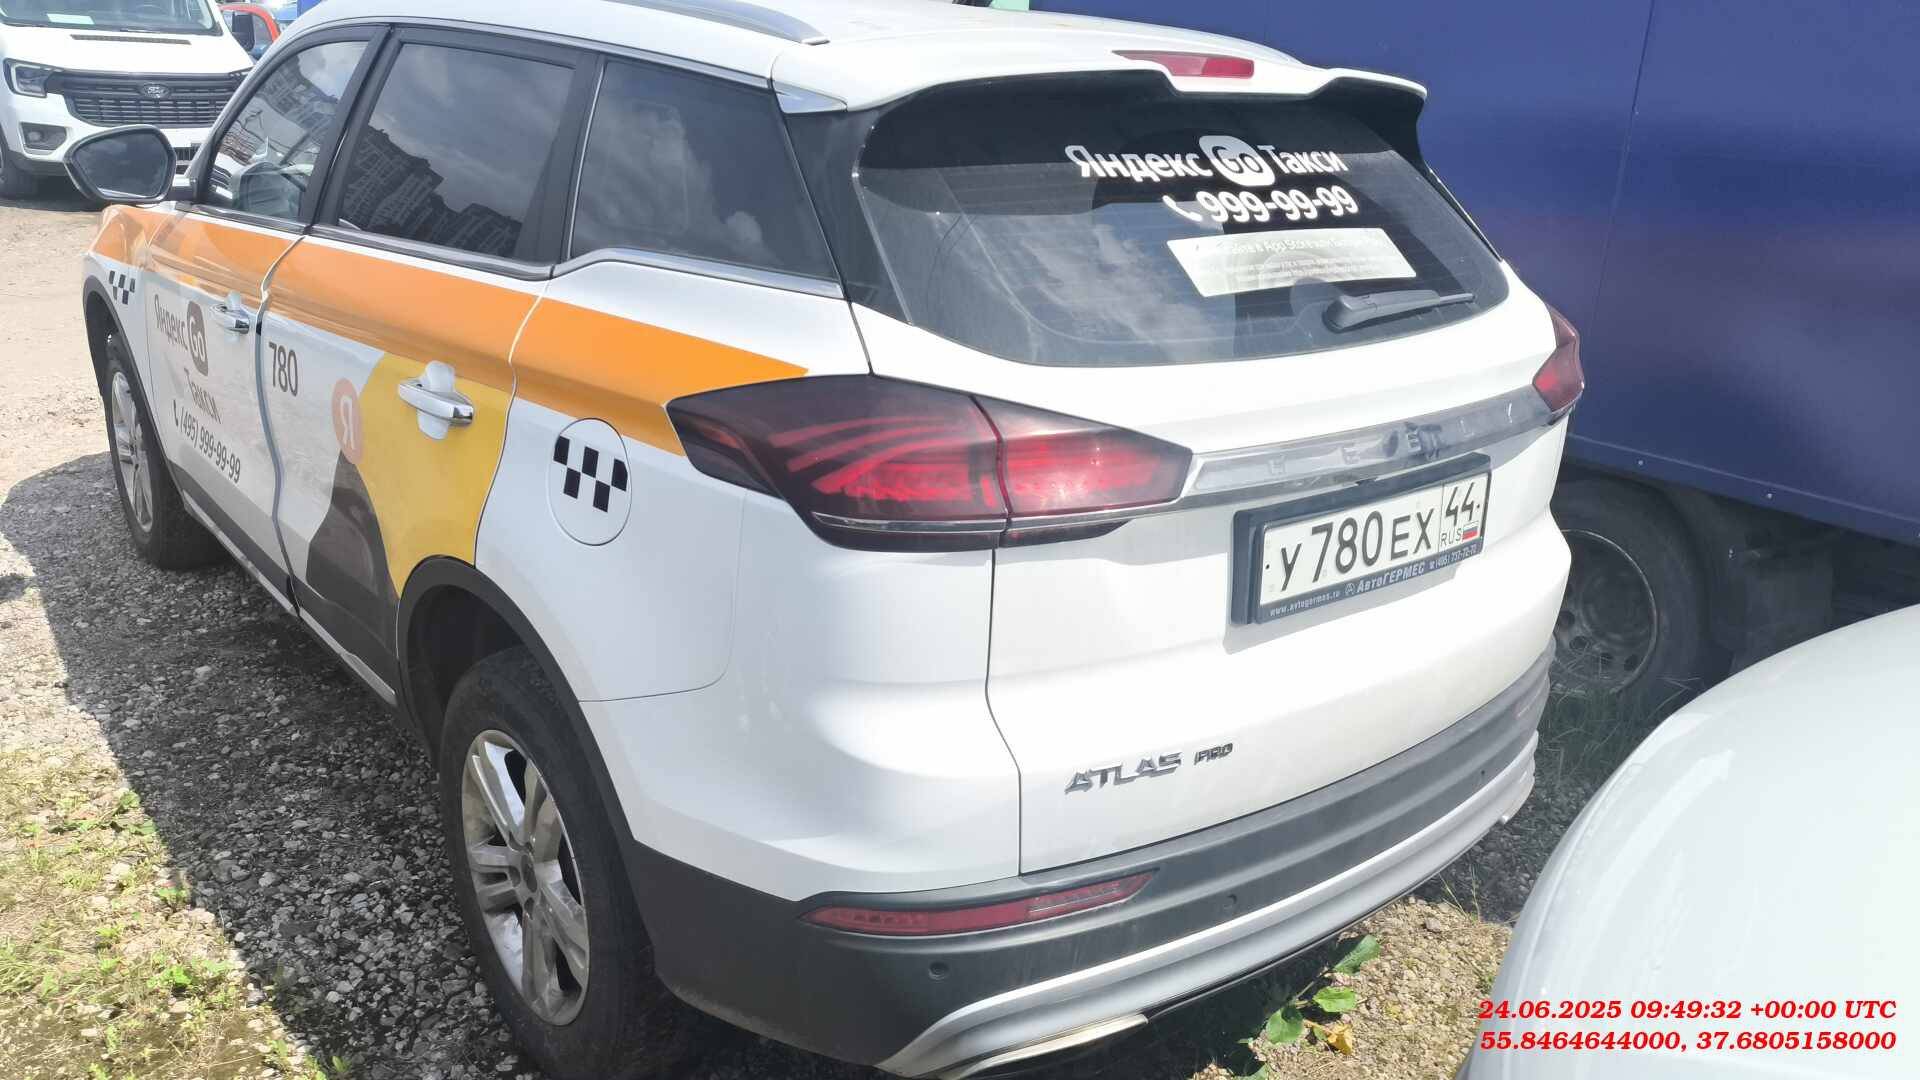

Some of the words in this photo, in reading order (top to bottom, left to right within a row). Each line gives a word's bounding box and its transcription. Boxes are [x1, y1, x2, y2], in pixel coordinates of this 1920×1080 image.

[1065, 145, 1213, 182] Яндекс
[1258, 144, 1349, 176] Такси
[1195, 185, 1359, 223] 999-99-99
[154, 293, 188, 351] Яндекс
[268, 341, 299, 397] 780
[183, 366, 221, 424] Такси
[180, 405, 199, 449] (495)
[199, 426, 241, 484] 999-99-99
[1445, 481, 1477, 527] 44
[1440, 529, 1461, 546] RUS
[1064, 751, 1183, 795] ATLAS
